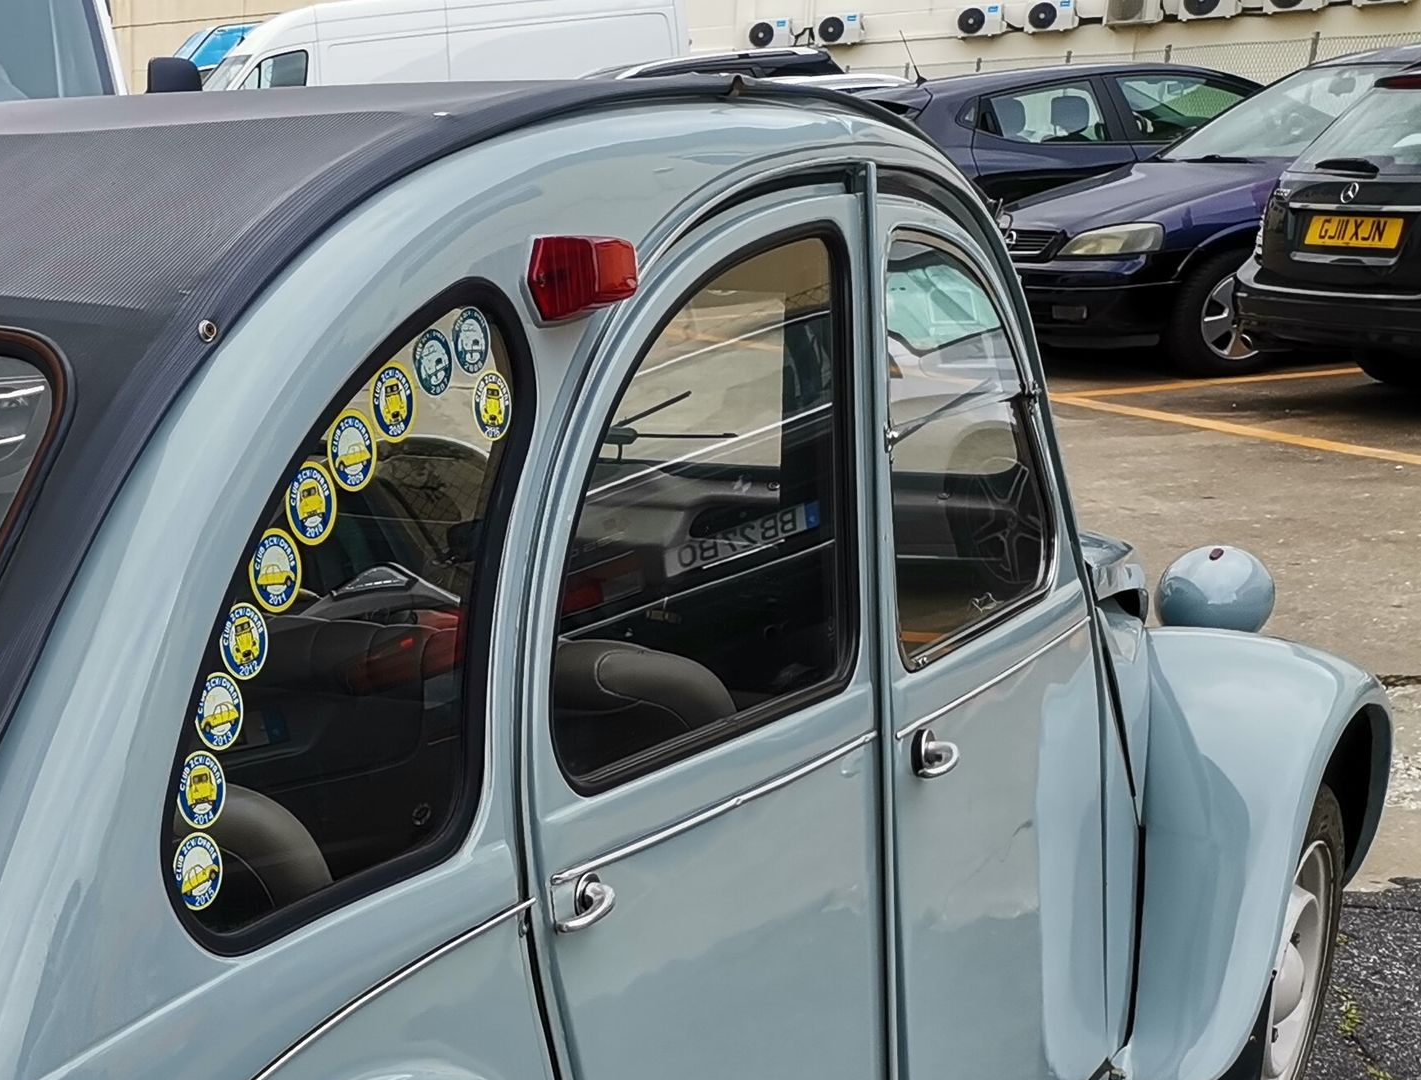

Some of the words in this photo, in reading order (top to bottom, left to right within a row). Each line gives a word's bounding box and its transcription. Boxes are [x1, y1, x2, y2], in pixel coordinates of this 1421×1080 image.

[1318, 218, 1350, 241] GJ11
[1349, 219, 1388, 242] XJN
[306, 524, 323, 537] 2010
[269, 593, 287, 605] 2011
[223, 621, 232, 646] CLUB
[240, 660, 260, 676] 2012
[198, 690, 207, 714] CLUB
[213, 731, 232, 746] 2013
[180, 766, 190, 791] CLUB
[194, 811, 213, 824] 2014
[176, 855, 184, 881] CLUB
[195, 887, 215, 906] 2015
